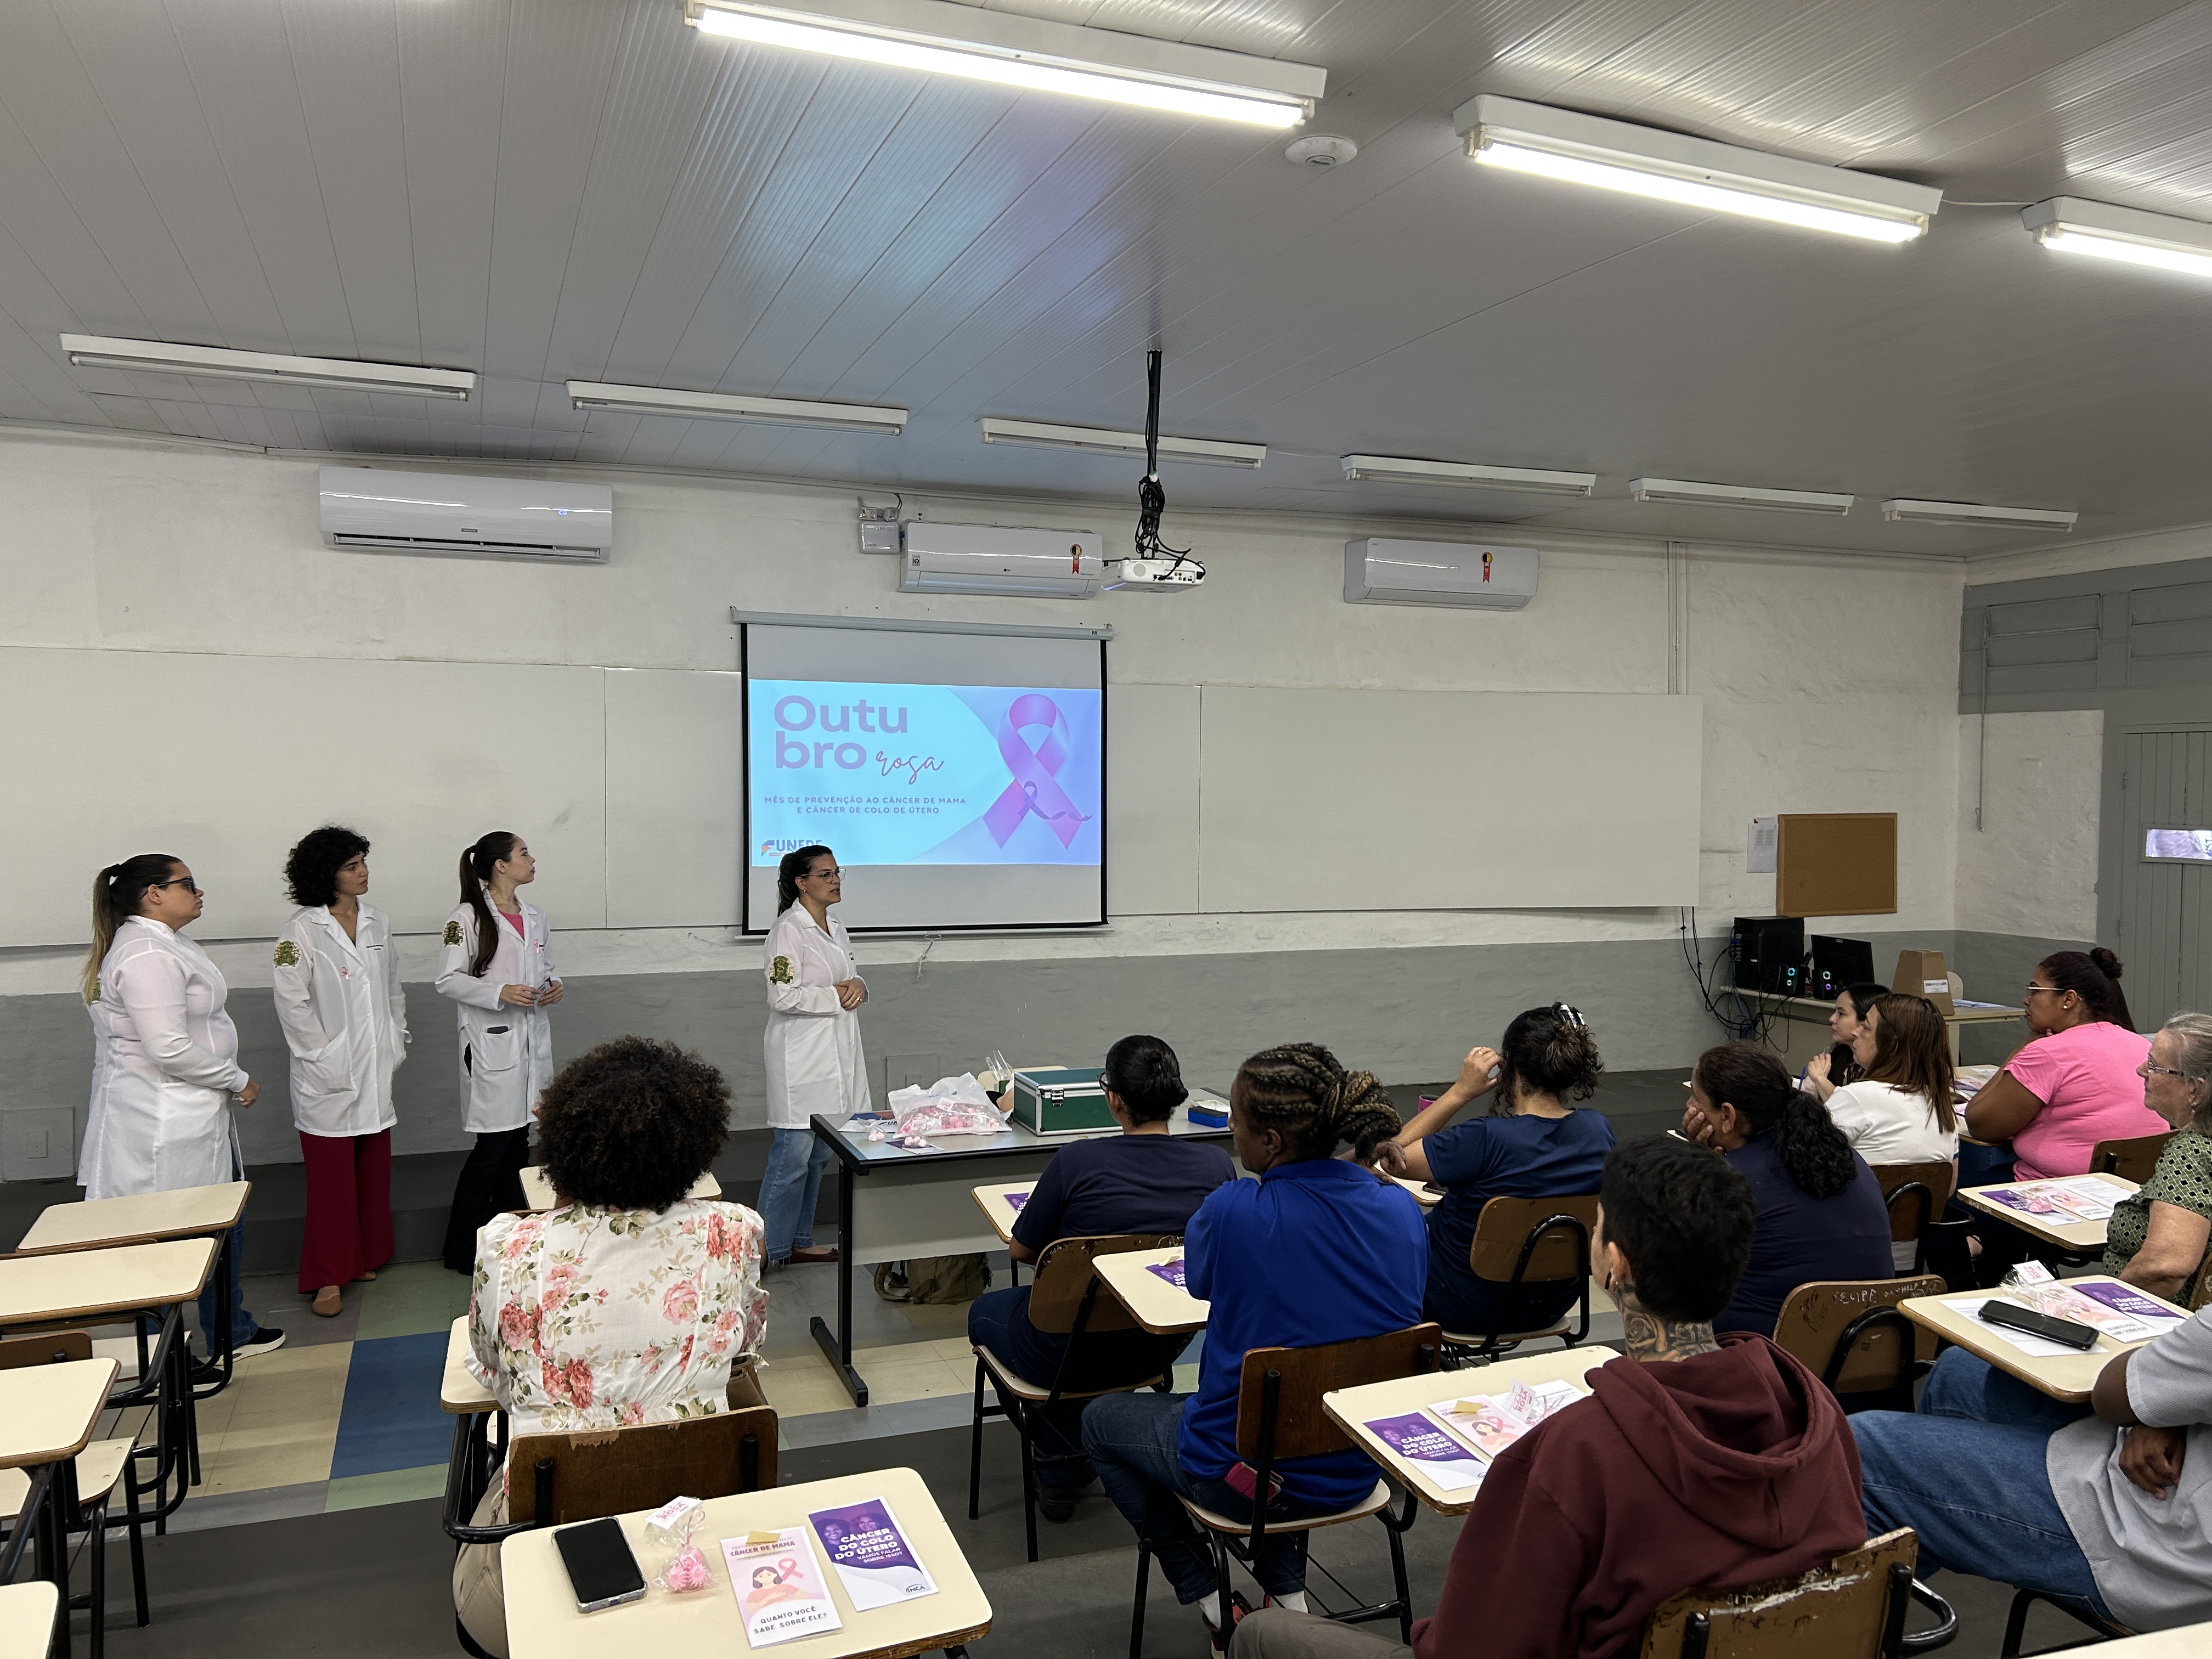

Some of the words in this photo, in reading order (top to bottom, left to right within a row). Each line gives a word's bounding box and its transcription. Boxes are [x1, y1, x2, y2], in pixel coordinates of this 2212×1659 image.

[774, 695, 907, 733] Outu
[776, 731, 866, 769] bro
[876, 751, 944, 785] rosa
[805, 795, 862, 804] PREVENÇÃO
[1419, 1437, 1446, 1446] COLO
[838, 1543, 857, 1551] DO
[860, 1535, 894, 1546] COLO
[841, 1528, 890, 1543] CÂNCER
[835, 1551, 854, 1560] DO
[856, 1542, 898, 1554] ÚTERO
[857, 1551, 880, 1560] VAMOS
[760, 1612, 793, 1623] QUANTO
[794, 1606, 816, 1615] VOCÊ
[754, 1624, 775, 1634] SABE
[780, 1617, 806, 1628] SOBRE
[809, 1613, 826, 1621] ELE?
